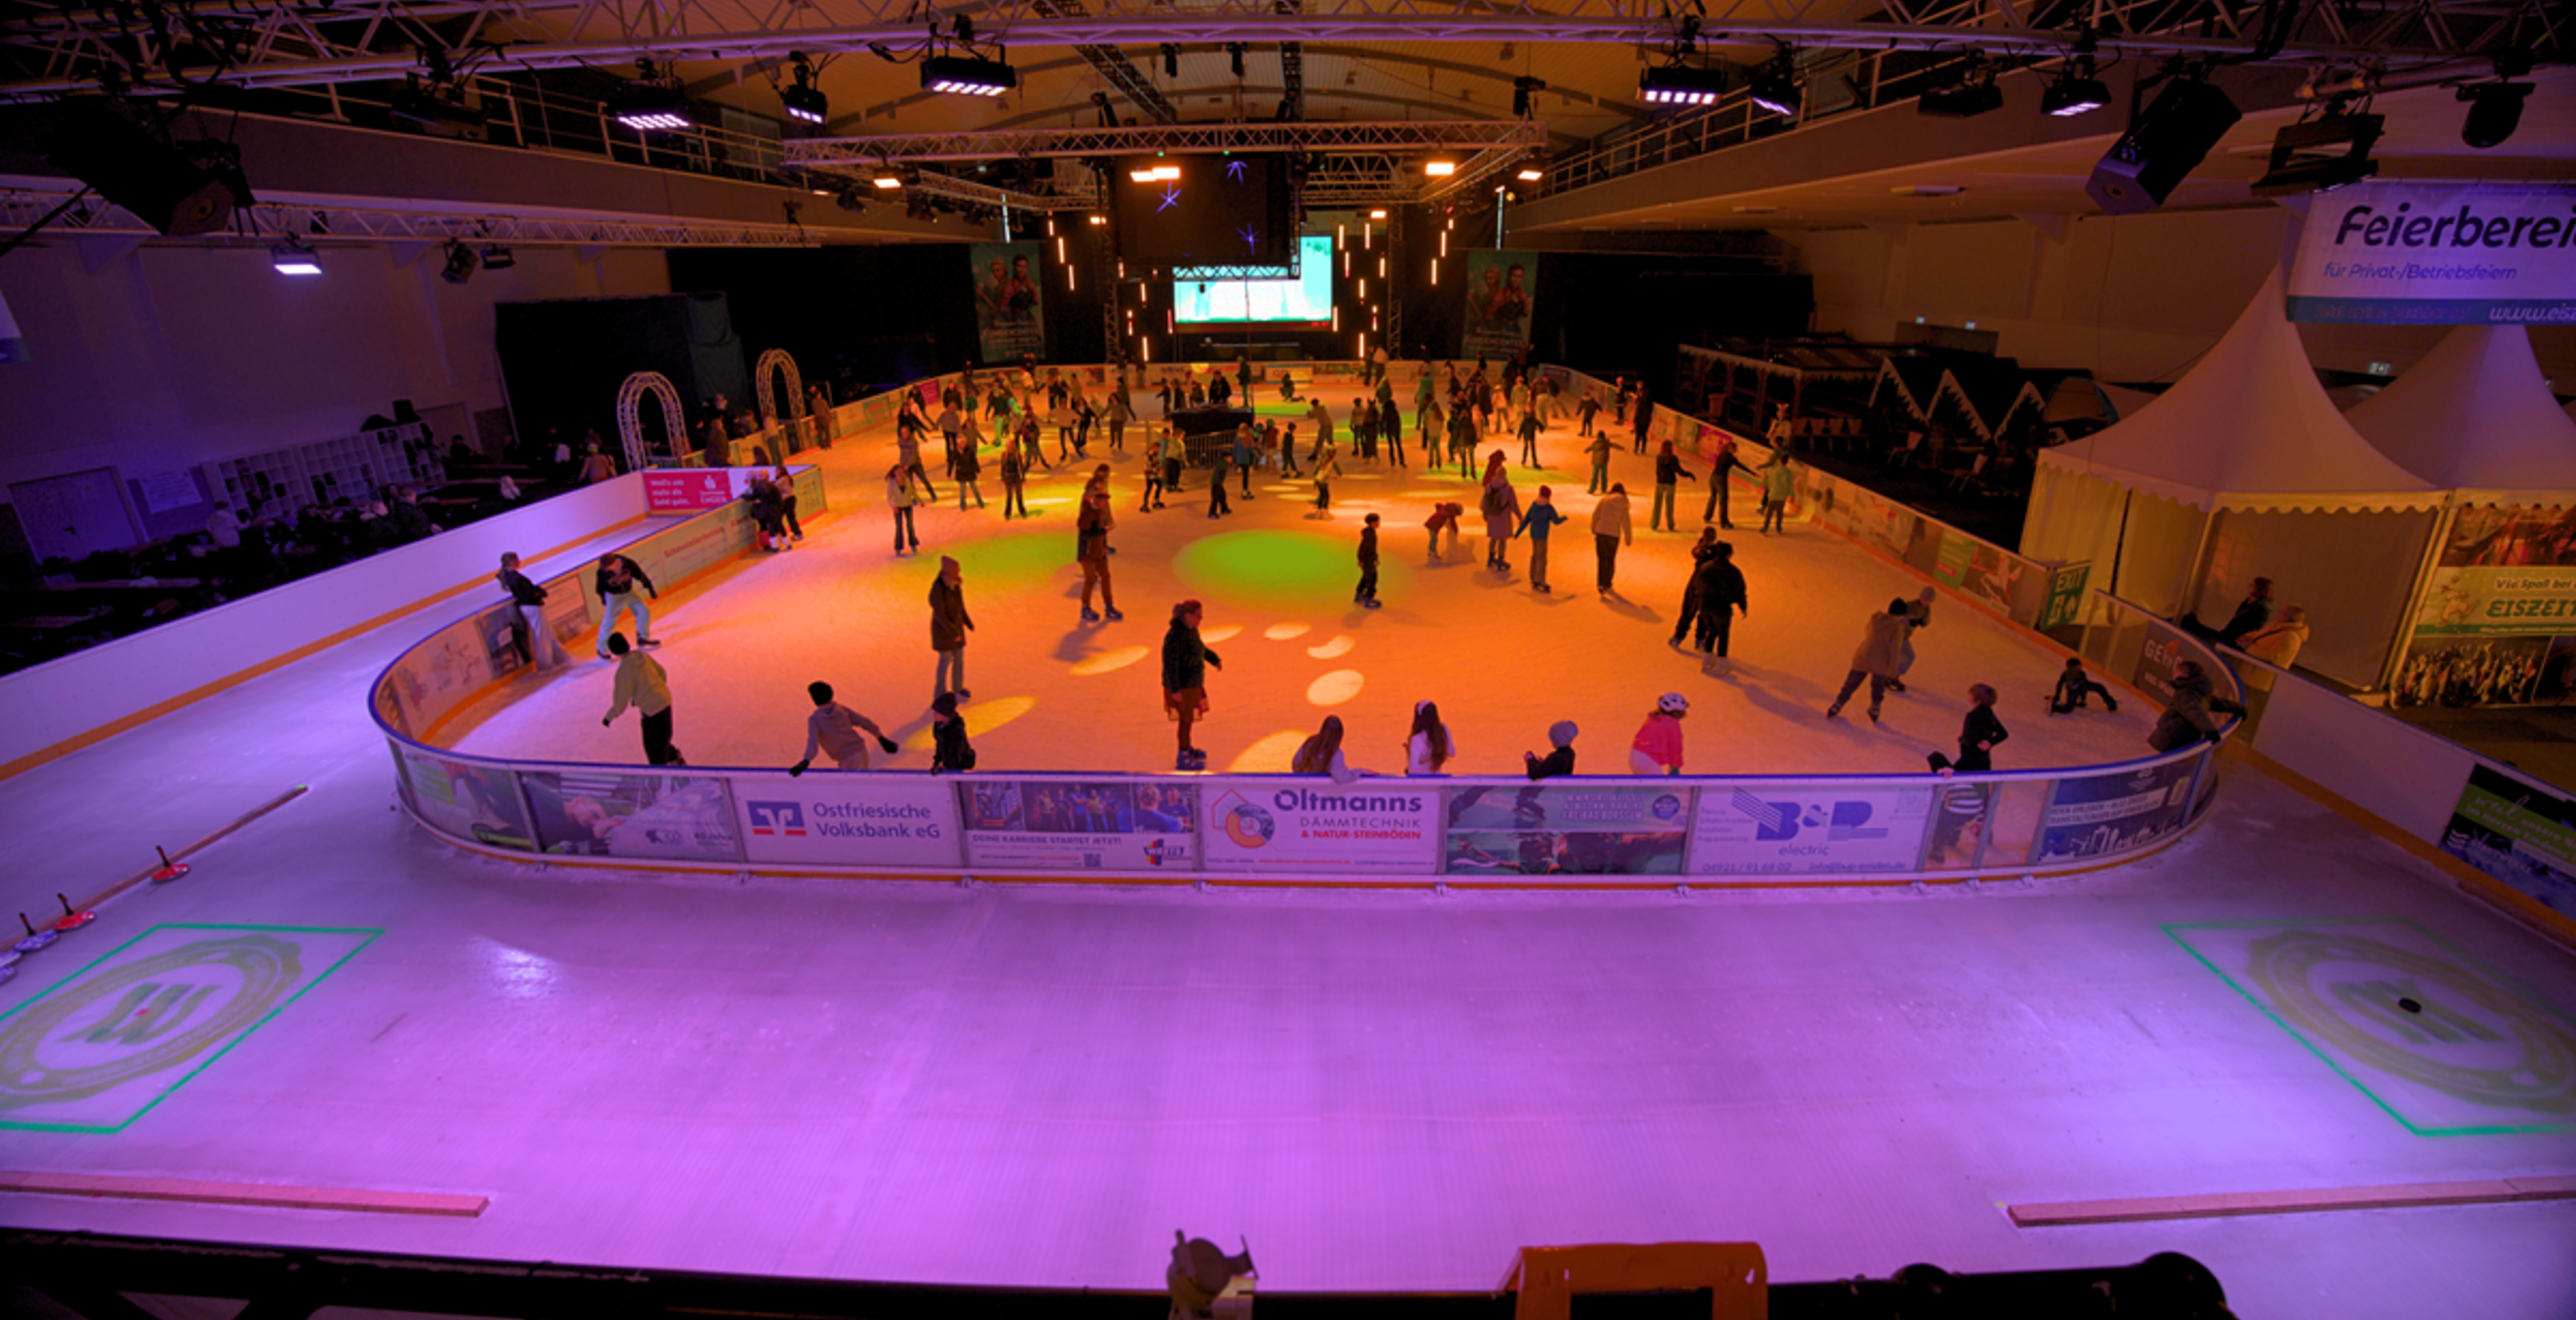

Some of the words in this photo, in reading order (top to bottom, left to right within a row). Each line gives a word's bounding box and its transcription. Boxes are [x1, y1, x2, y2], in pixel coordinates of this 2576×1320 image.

[2334, 202, 2576, 248] Feierberei
[2323, 262, 2347, 278] für
[2350, 262, 2517, 281] Privat-/Betriebsfeiern
[2315, 305, 2345, 320] Jetzt
[2347, 305, 2387, 319] online
[2390, 305, 2443, 320] buchbar
[2055, 569, 2086, 593] EXIT
[2521, 580, 2550, 590] Spaß
[1274, 788, 1422, 812] Oltmanns
[814, 803, 931, 818] Ostfriesische
[1300, 815, 1421, 828] DÄMMTECHNIK
[816, 822, 911, 838] Volksbank
[915, 824, 941, 839] eG
[1301, 830, 1309, 839] &
[1313, 829, 1421, 839] NATUR-STEINBÖDEN
[2482, 812, 2521, 836] Herzen
[2523, 832, 2569, 859] Emdens
[2521, 819, 2562, 842] unsere
[1002, 835, 1048, 844] KARRIERE
[1050, 836, 1091, 845] STARTET
[1092, 837, 1122, 846] JETZT!
[1778, 843, 1830, 857] electric
[1701, 863, 1736, 872] 04921
[1746, 863, 1759, 872] 91
[1762, 863, 1776, 872] 69
[1777, 863, 1792, 872] 02
